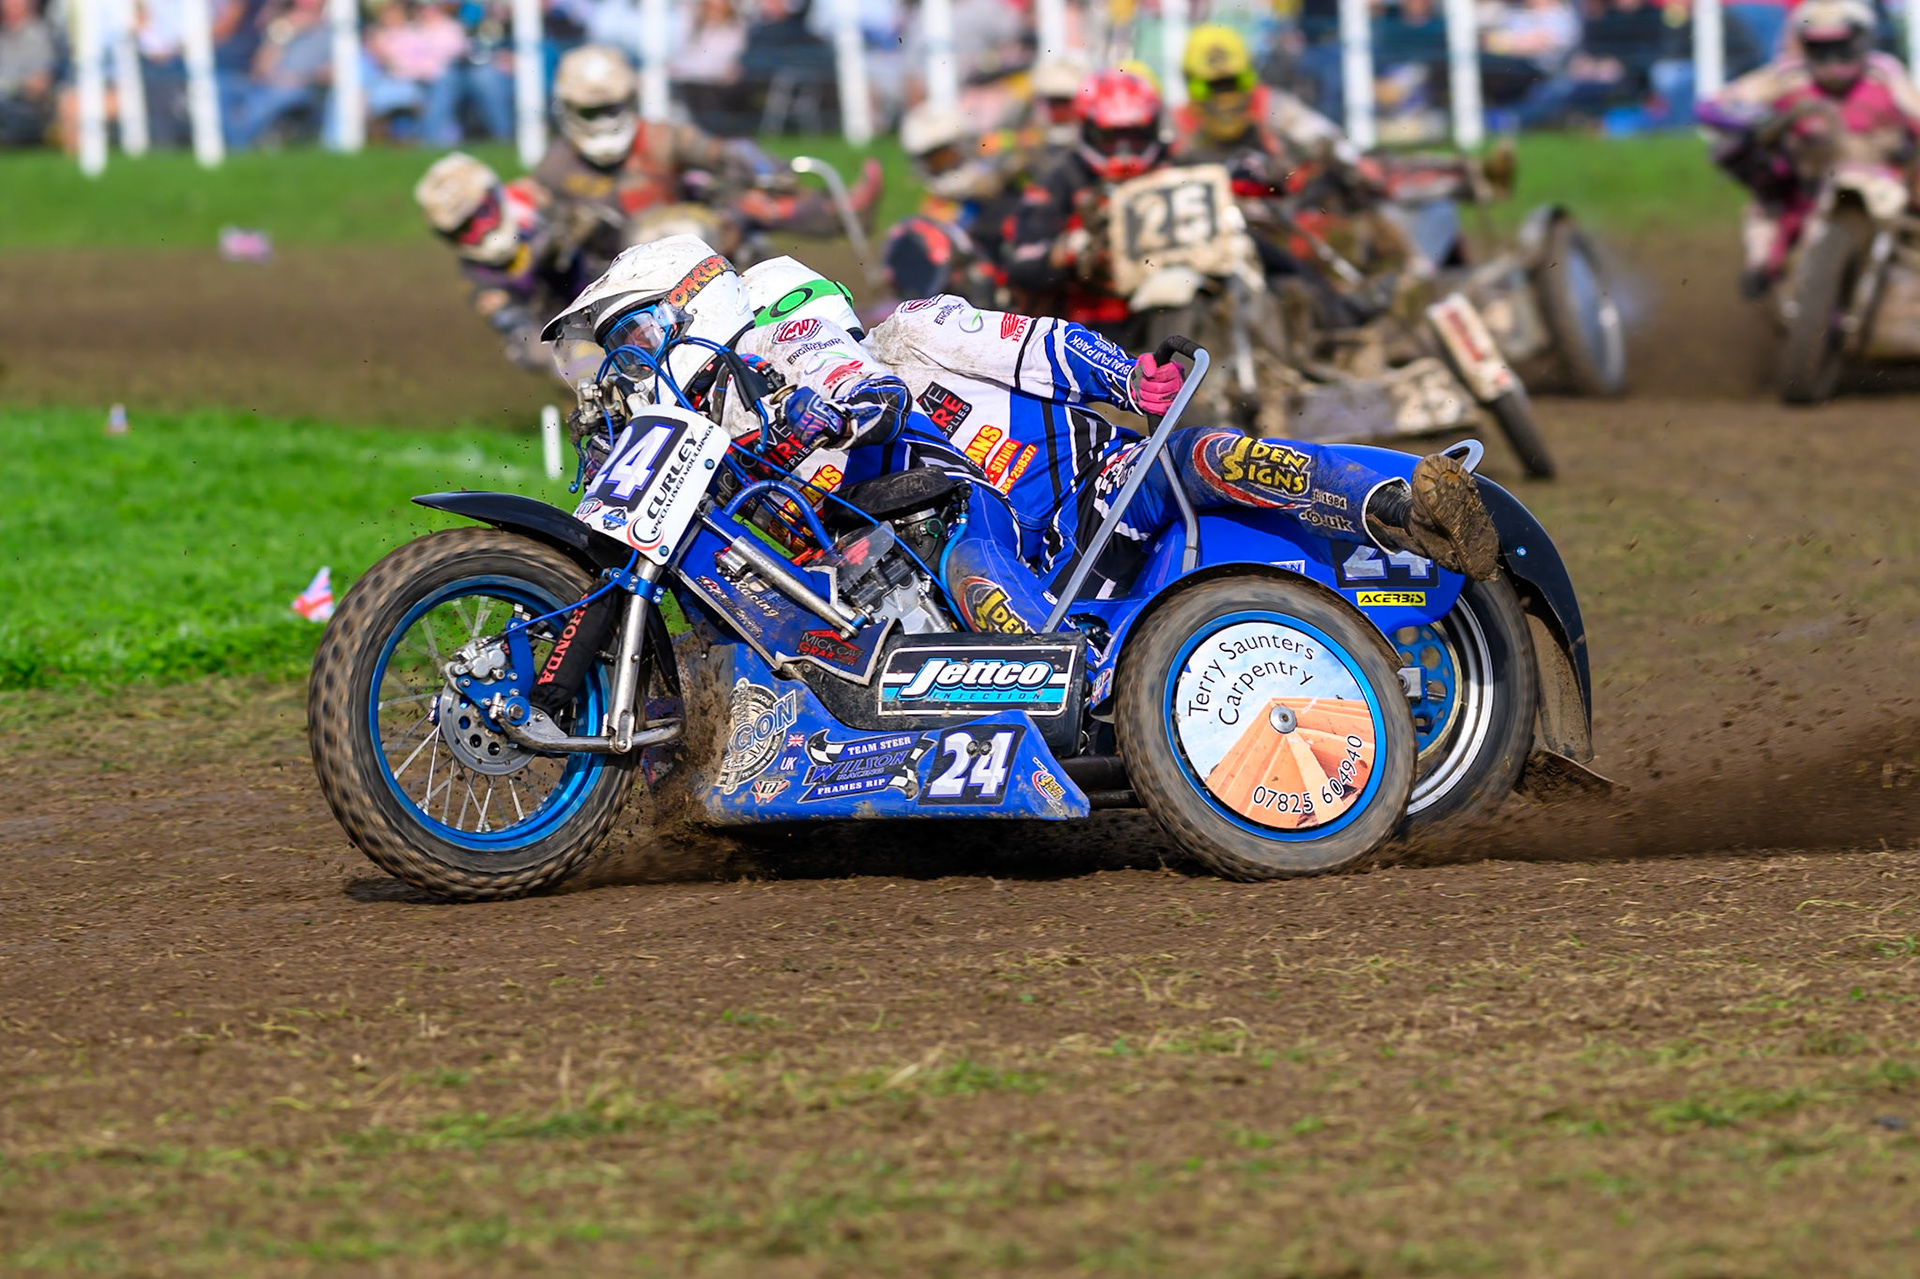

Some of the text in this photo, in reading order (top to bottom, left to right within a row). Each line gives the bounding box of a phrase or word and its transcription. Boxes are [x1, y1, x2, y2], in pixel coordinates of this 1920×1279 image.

[1135, 184, 1211, 249] 25
[668, 256, 727, 307] OAKLEY
[1069, 334, 1098, 357] PARK
[646, 430, 698, 520] CURLEY
[649, 424, 715, 536] SPECIALISED MOULDINGS
[1222, 454, 1304, 492] SIGNS
[537, 607, 587, 686] HONDA
[801, 632, 837, 651] MICK
[900, 658, 1051, 698] Jettco
[931, 691, 1042, 701] INJECTION
[1187, 633, 1315, 718] Terry Saunters
[1217, 660, 1315, 726] Carpentry
[780, 757, 798, 771] UK
[809, 750, 910, 783] WILSON
[847, 736, 912, 756] TEAM STEER
[927, 730, 1016, 798] 24
[865, 778, 887, 789] RIP
[1252, 734, 1364, 815] 07825 604940
